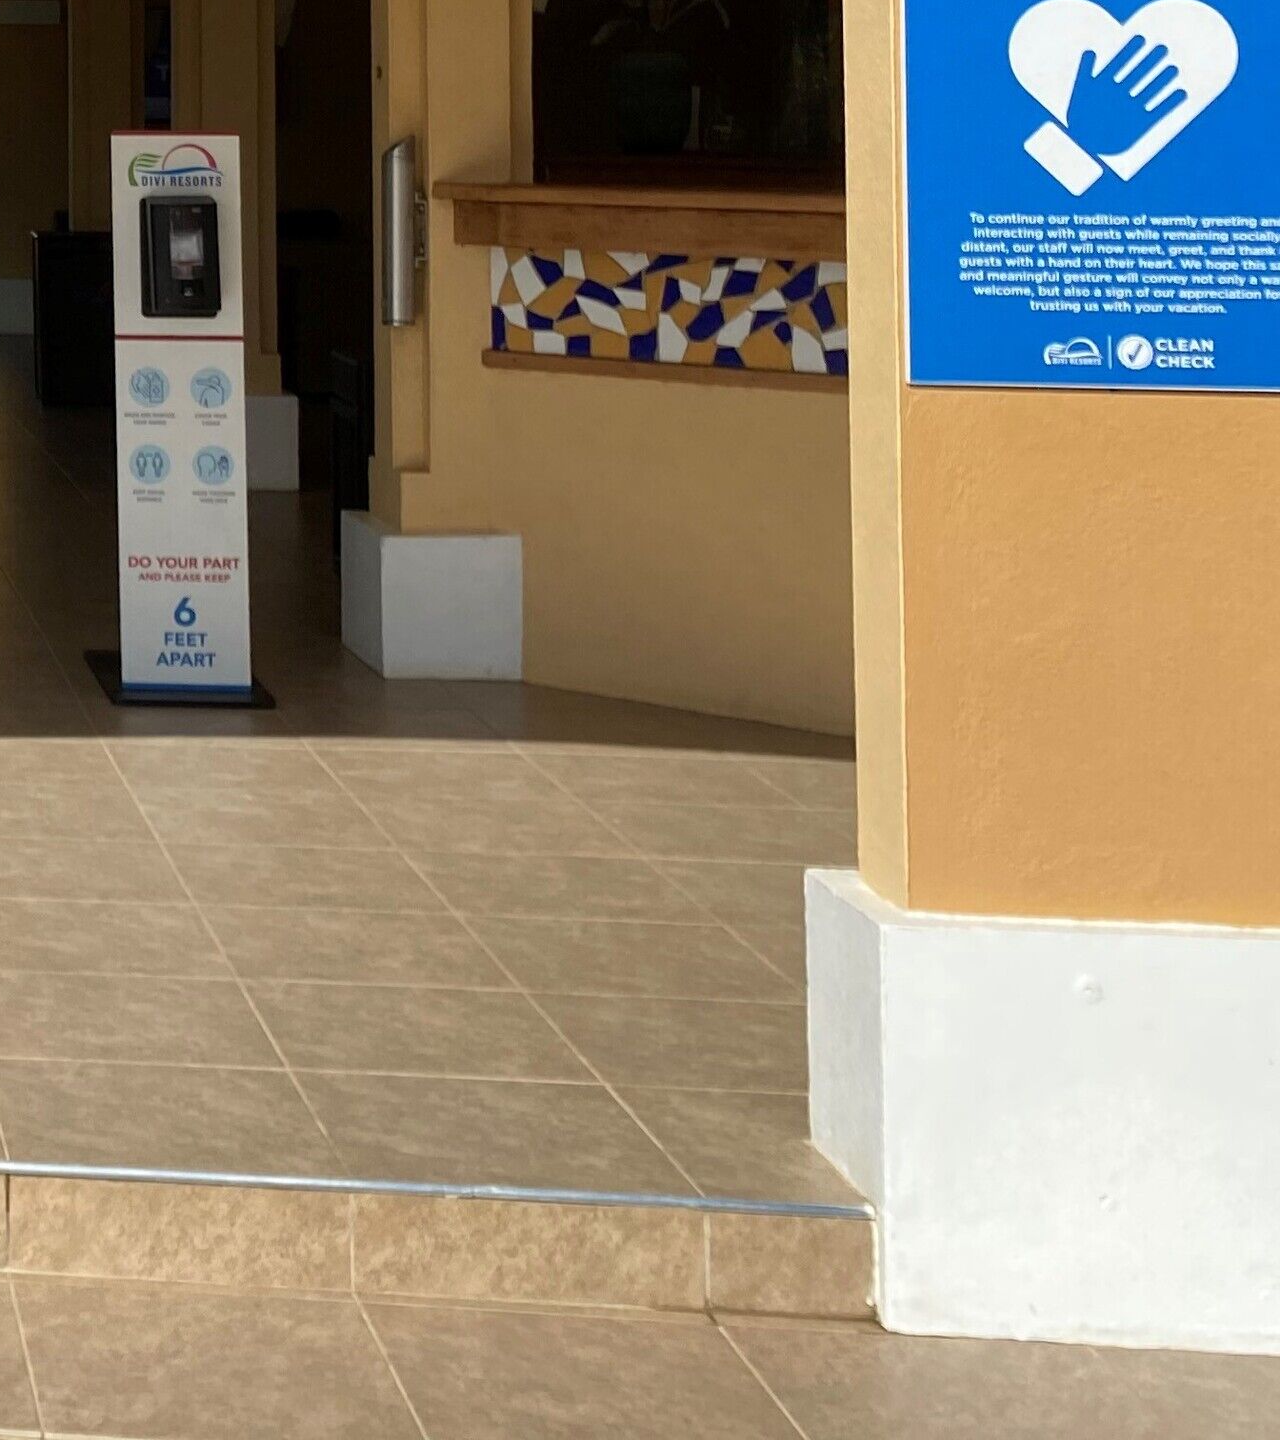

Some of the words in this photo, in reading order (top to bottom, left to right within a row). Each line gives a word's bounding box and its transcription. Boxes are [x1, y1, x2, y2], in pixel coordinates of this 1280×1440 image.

[141, 176, 165, 186] DIVI
[170, 176, 222, 187] RESORTS
[969, 212, 985, 223] To
[988, 214, 1044, 225] continue
[1048, 215, 1070, 225] our
[1073, 214, 1129, 226] tradition
[1133, 215, 1147, 226] of
[1150, 215, 1198, 228] warmly
[1201, 216, 1257, 229] greeting
[1047, 228, 1075, 239] with
[1079, 229, 1121, 241] guests
[1124, 229, 1160, 240] while
[1163, 231, 1229, 243] remaining
[961, 242, 1009, 254] distant,
[1013, 244, 1035, 253] our
[1038, 242, 1068, 253] staff
[1071, 243, 1093, 254] will
[1097, 244, 1124, 254] now
[1210, 245, 1235, 255] and
[1238, 245, 1276, 256] thank
[959, 257, 1002, 268] guests
[1005, 257, 1033, 267] with
[1037, 258, 1045, 267] a
[1048, 257, 1081, 268] hand
[1084, 259, 1101, 268] on
[1104, 258, 1135, 269] their
[1180, 259, 1202, 270] We
[1205, 260, 1239, 271] hope
[1241, 260, 1267, 270] this
[959, 271, 984, 281] and
[987, 271, 1060, 284] meaningful
[1063, 272, 1112, 284] gesture
[1116, 272, 1138, 283] will
[1142, 274, 1189, 285] convey
[1191, 274, 1214, 284] not
[1217, 274, 1246, 286] only
[1249, 275, 1258, 285] a
[974, 285, 1035, 298] welcome,
[1038, 285, 1060, 296] but
[1064, 286, 1090, 297] also
[1093, 288, 1102, 297] a
[1105, 287, 1132, 299] sign
[1136, 287, 1150, 297] of
[1153, 289, 1176, 298] our
[1178, 289, 1262, 300] appreciation
[1030, 300, 1081, 313] trusting
[1084, 302, 1099, 311] us
[1102, 301, 1131, 312] with
[1134, 303, 1164, 313] your
[1155, 337, 1214, 352] CLEAN
[1155, 354, 1215, 369] CHECK
[128, 556, 151, 568] DO
[157, 556, 198, 569] YOUR
[203, 558, 240, 569] PART
[139, 573, 162, 581] AND
[164, 573, 200, 582] PLEASE
[204, 574, 231, 582] KEEP
[174, 597, 196, 627] 6
[164, 632, 208, 647] FEET
[156, 652, 216, 668] APART
